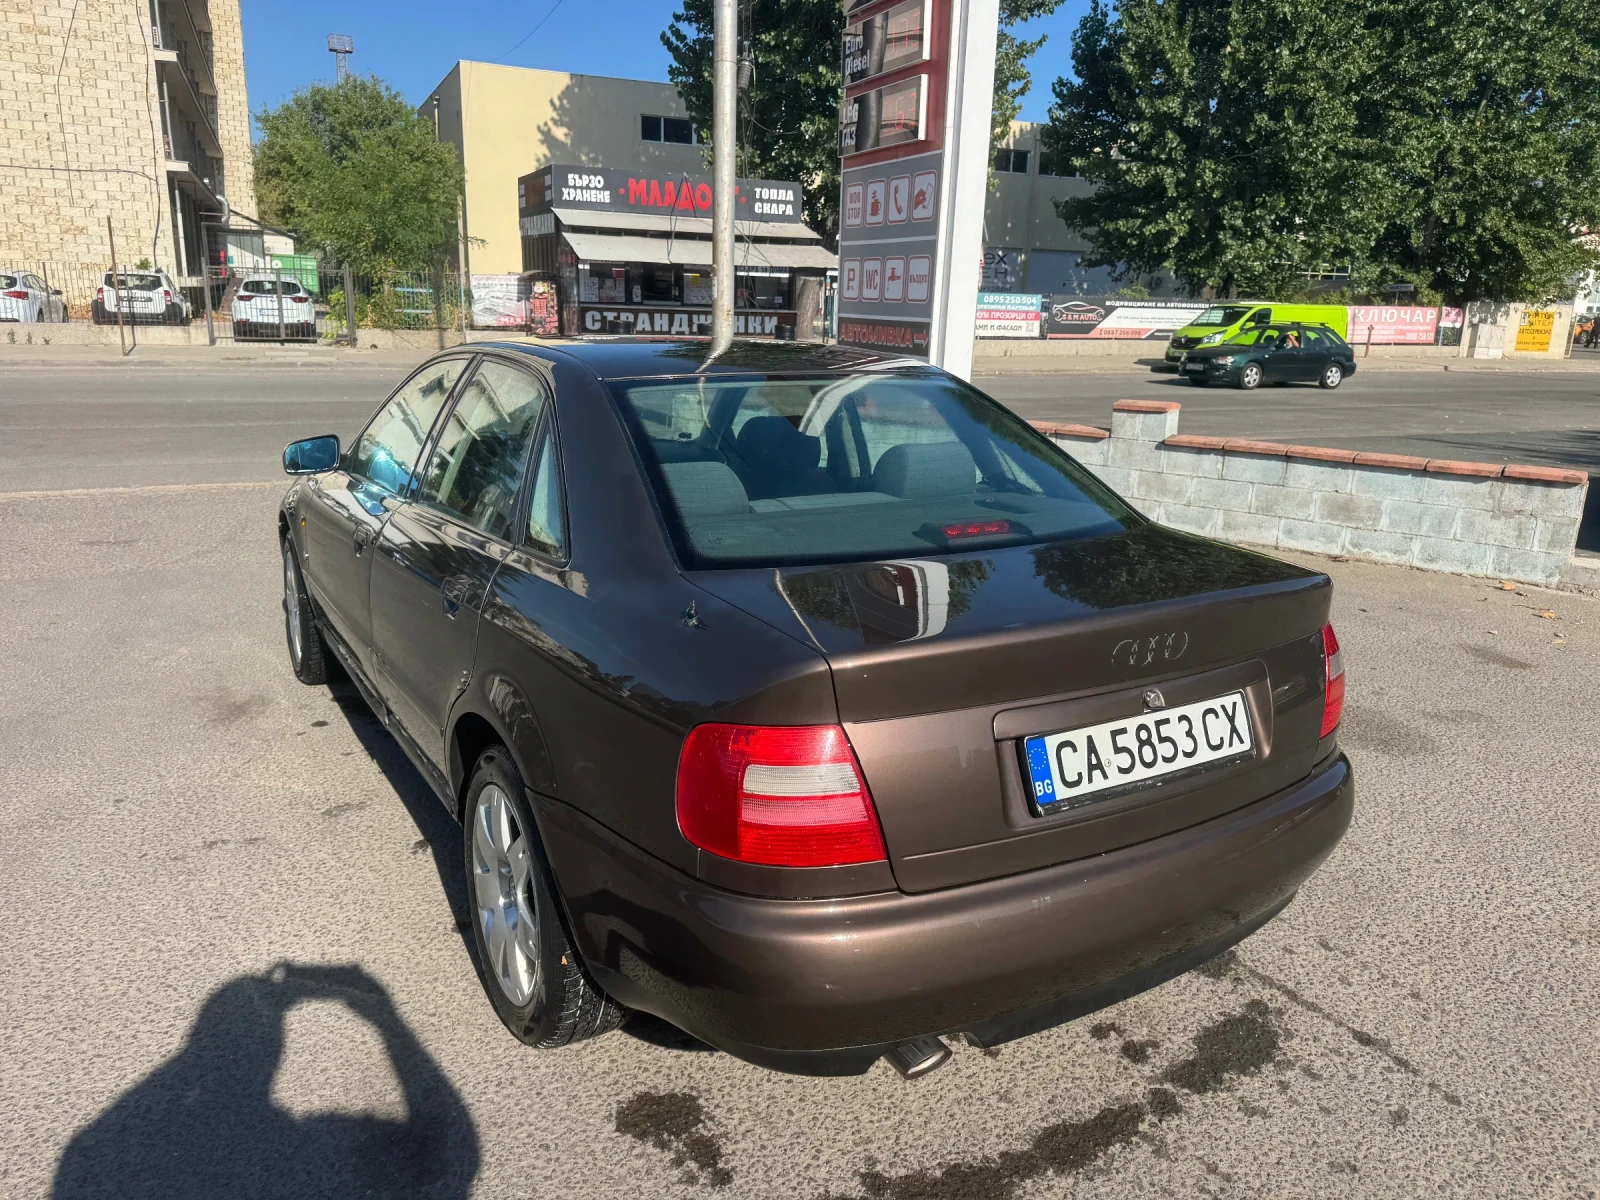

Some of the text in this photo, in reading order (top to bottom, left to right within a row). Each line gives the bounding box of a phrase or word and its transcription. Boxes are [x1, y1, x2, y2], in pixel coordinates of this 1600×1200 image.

[845, 35, 864, 55] Euro
[844, 49, 870, 76] Diesel
[842, 103, 859, 124] LPG
[841, 128, 857, 147] ГАЗ
[567, 173, 605, 188] БЪРЗО
[561, 187, 611, 203] ХРАНЕНЕ
[627, 177, 740, 211] МЛАДО
[753, 187, 795, 202] ТОПЛА
[848, 191, 861, 204] NON
[754, 201, 794, 216] СКАРА
[865, 269, 879, 290] WC
[983, 295, 1005, 304] 0895
[1105, 300, 1156, 308] МОДИФИЦИРАНЕ
[584, 310, 779, 335] СТРАНДЖНКИ
[1026, 312, 1037, 320] ОТ
[1355, 308, 1436, 323] КЛЮЧАР
[838, 322, 914, 348] АВТОМИВКА
[1055, 701, 1245, 789] CA 5853 CX
[1034, 780, 1053, 797] BG
